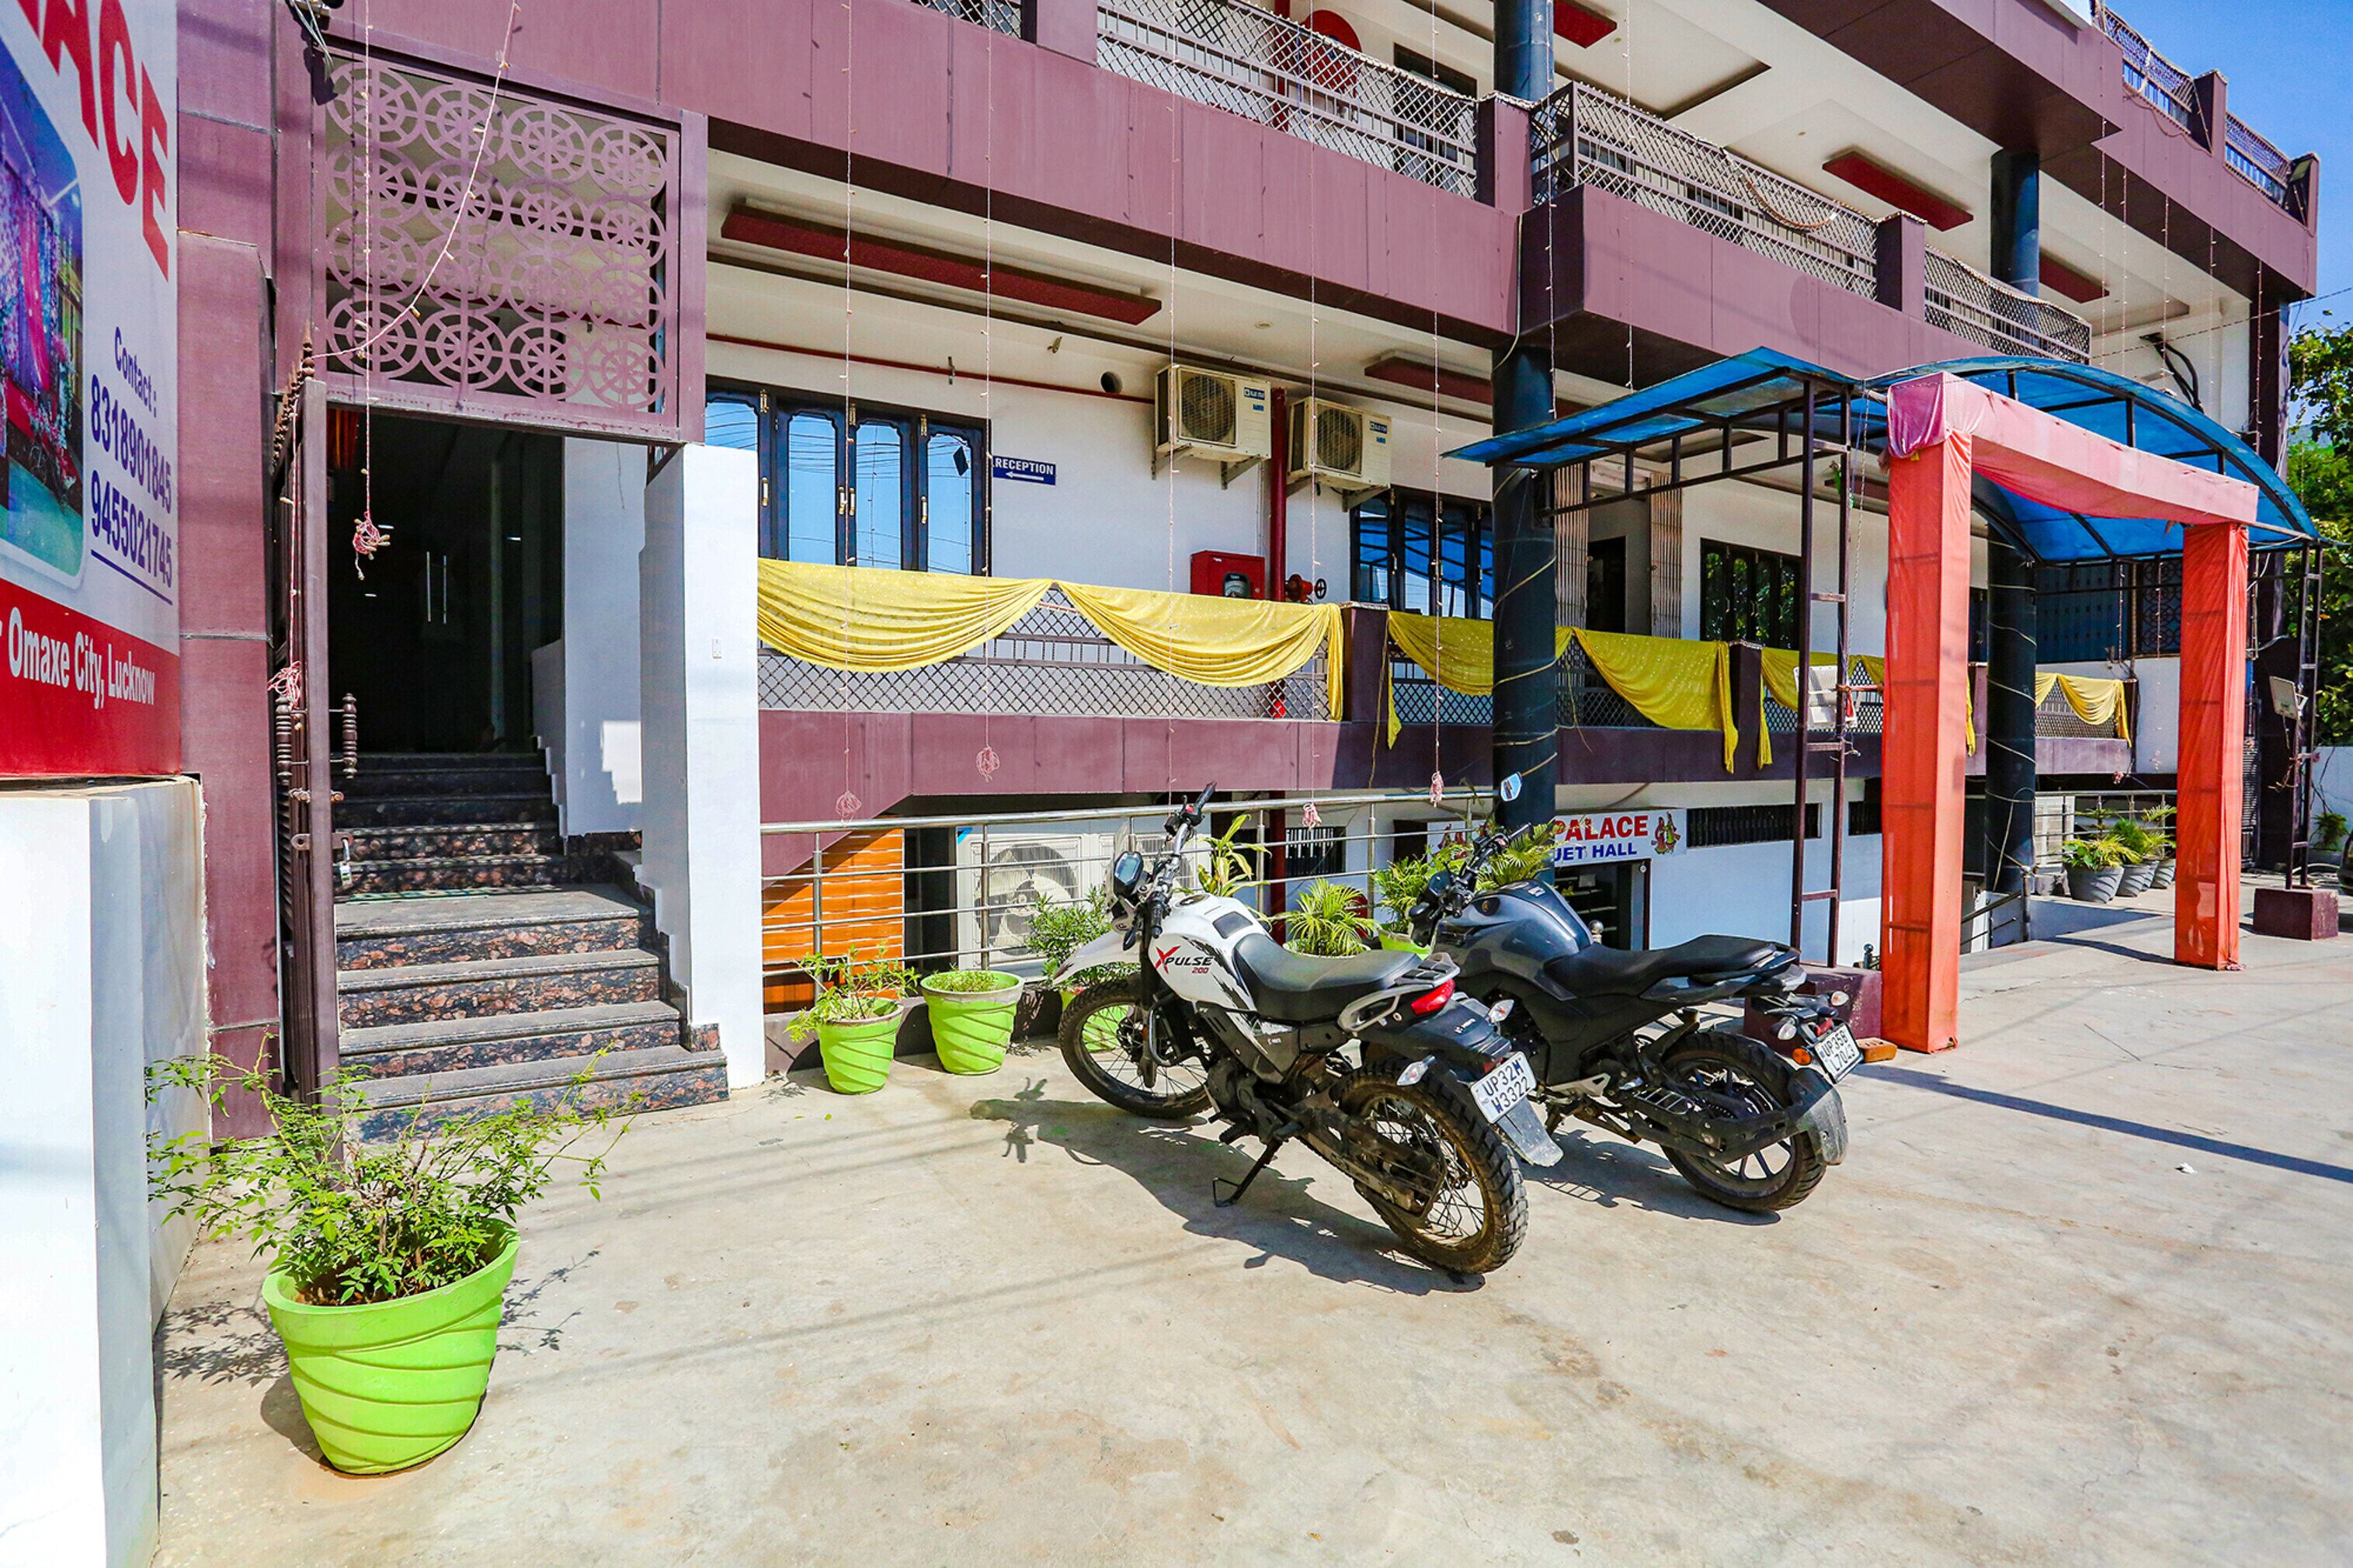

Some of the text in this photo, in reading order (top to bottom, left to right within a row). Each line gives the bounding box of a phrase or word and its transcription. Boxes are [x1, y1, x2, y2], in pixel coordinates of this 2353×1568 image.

[91, 374, 172, 514] 8318901845
[995, 457, 1054, 475] RECEPTION
[91, 470, 172, 588] 9455021745
[9, 607, 155, 709] Omaxe City, Lucknow
[1592, 843, 1637, 858] HALL
[1155, 945, 1215, 975] XPULSE
